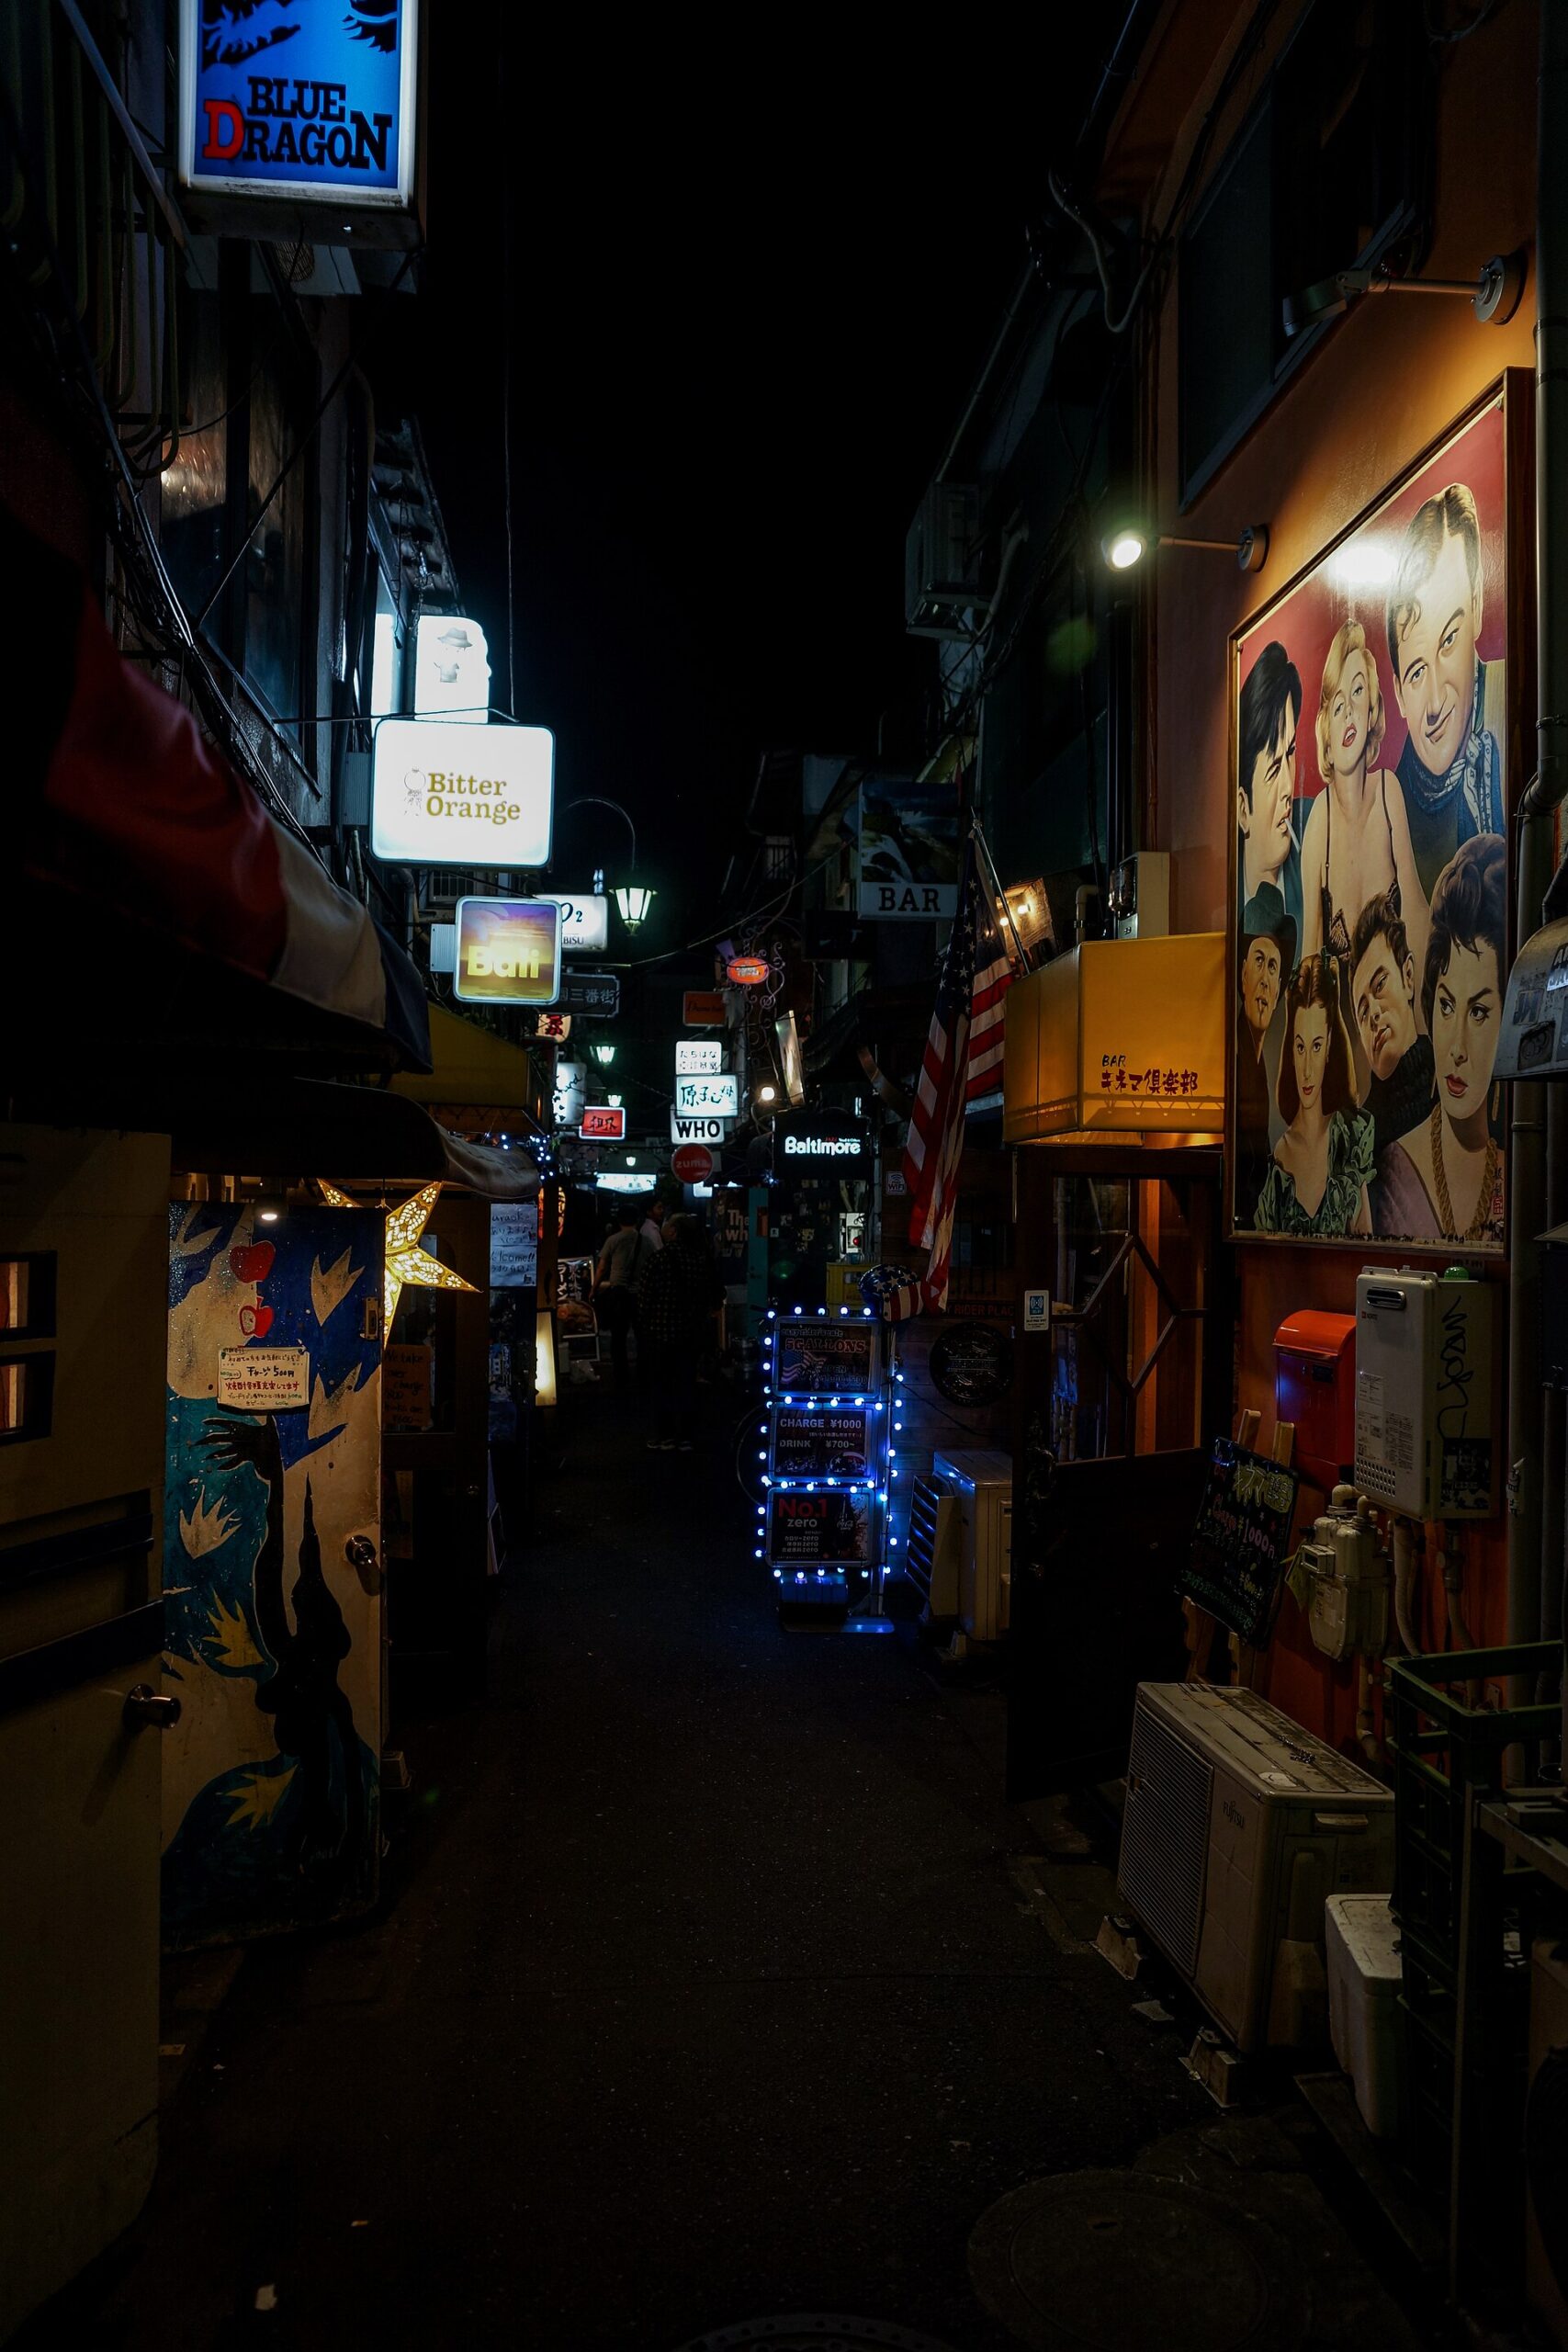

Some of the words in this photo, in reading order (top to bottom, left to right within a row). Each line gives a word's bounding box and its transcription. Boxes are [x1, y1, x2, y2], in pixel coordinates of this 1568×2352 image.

[247, 76, 346, 122] BLUE
[202, 99, 393, 171] DRAGON
[427, 772, 507, 796] Bitter
[426, 796, 521, 825] Orange
[878, 887, 941, 912] BAR
[1101, 1054, 1126, 1067] BAR
[675, 1120, 721, 1138] WHO
[784, 1136, 862, 1156] Baltimore
[780, 1419, 825, 1428] CHARGE
[830, 1419, 862, 1429] ¥1000
[779, 1440, 812, 1448] DRINK
[778, 1498, 829, 1518] No.1
[787, 1519, 818, 1528] zero
